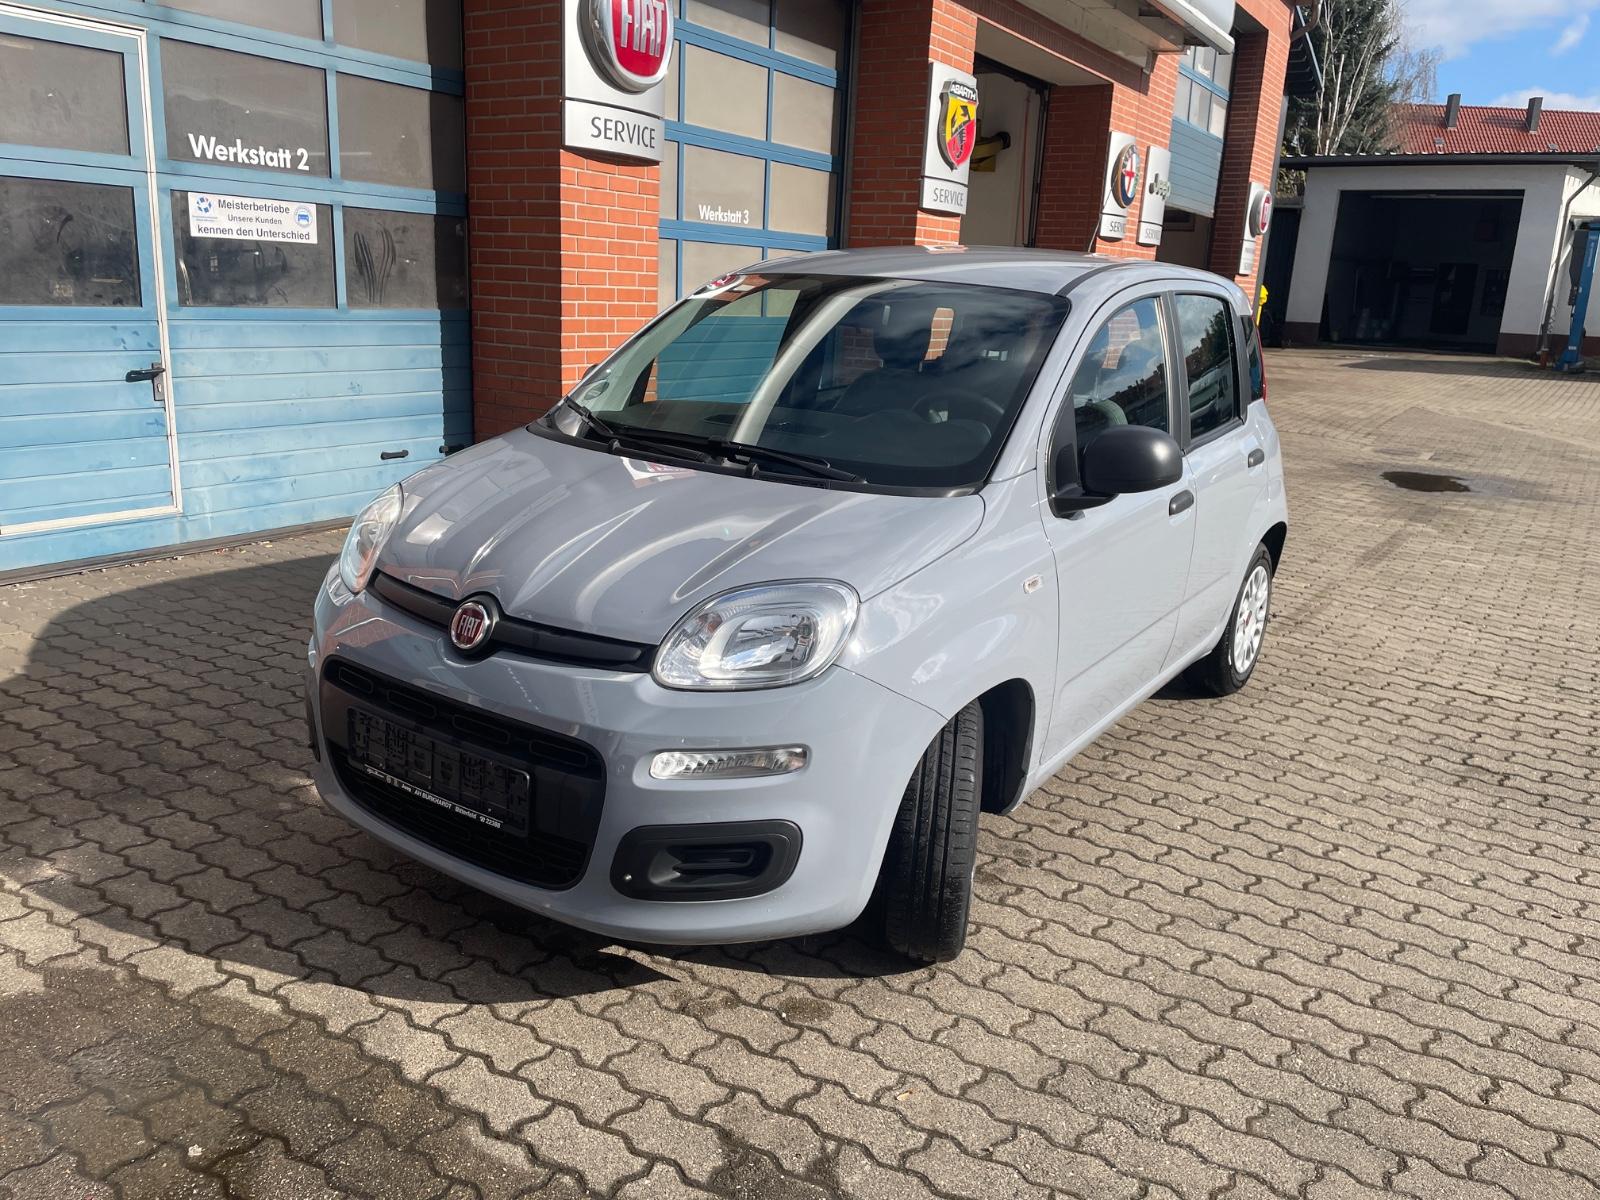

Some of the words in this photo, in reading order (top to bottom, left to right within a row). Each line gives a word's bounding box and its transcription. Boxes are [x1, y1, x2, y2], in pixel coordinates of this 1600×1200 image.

[620, 0, 664, 57] FIAT
[950, 83, 976, 101] ABARTH
[590, 116, 656, 149] SERVICE
[188, 133, 292, 169] Werkstatt
[296, 147, 310, 171] 2
[217, 199, 291, 214] Meisterbetriebe
[932, 187, 964, 207] SERVICE
[227, 213, 254, 223] Unsere
[255, 216, 283, 225] Kunden
[698, 204, 742, 224] Werkstatt
[743, 209, 750, 225] 3
[197, 224, 234, 236] kennen
[236, 227, 254, 237] den
[256, 228, 311, 241] Unterschied
[457, 614, 481, 638] FIAT
[422, 792, 452, 810] BURKHARDT
